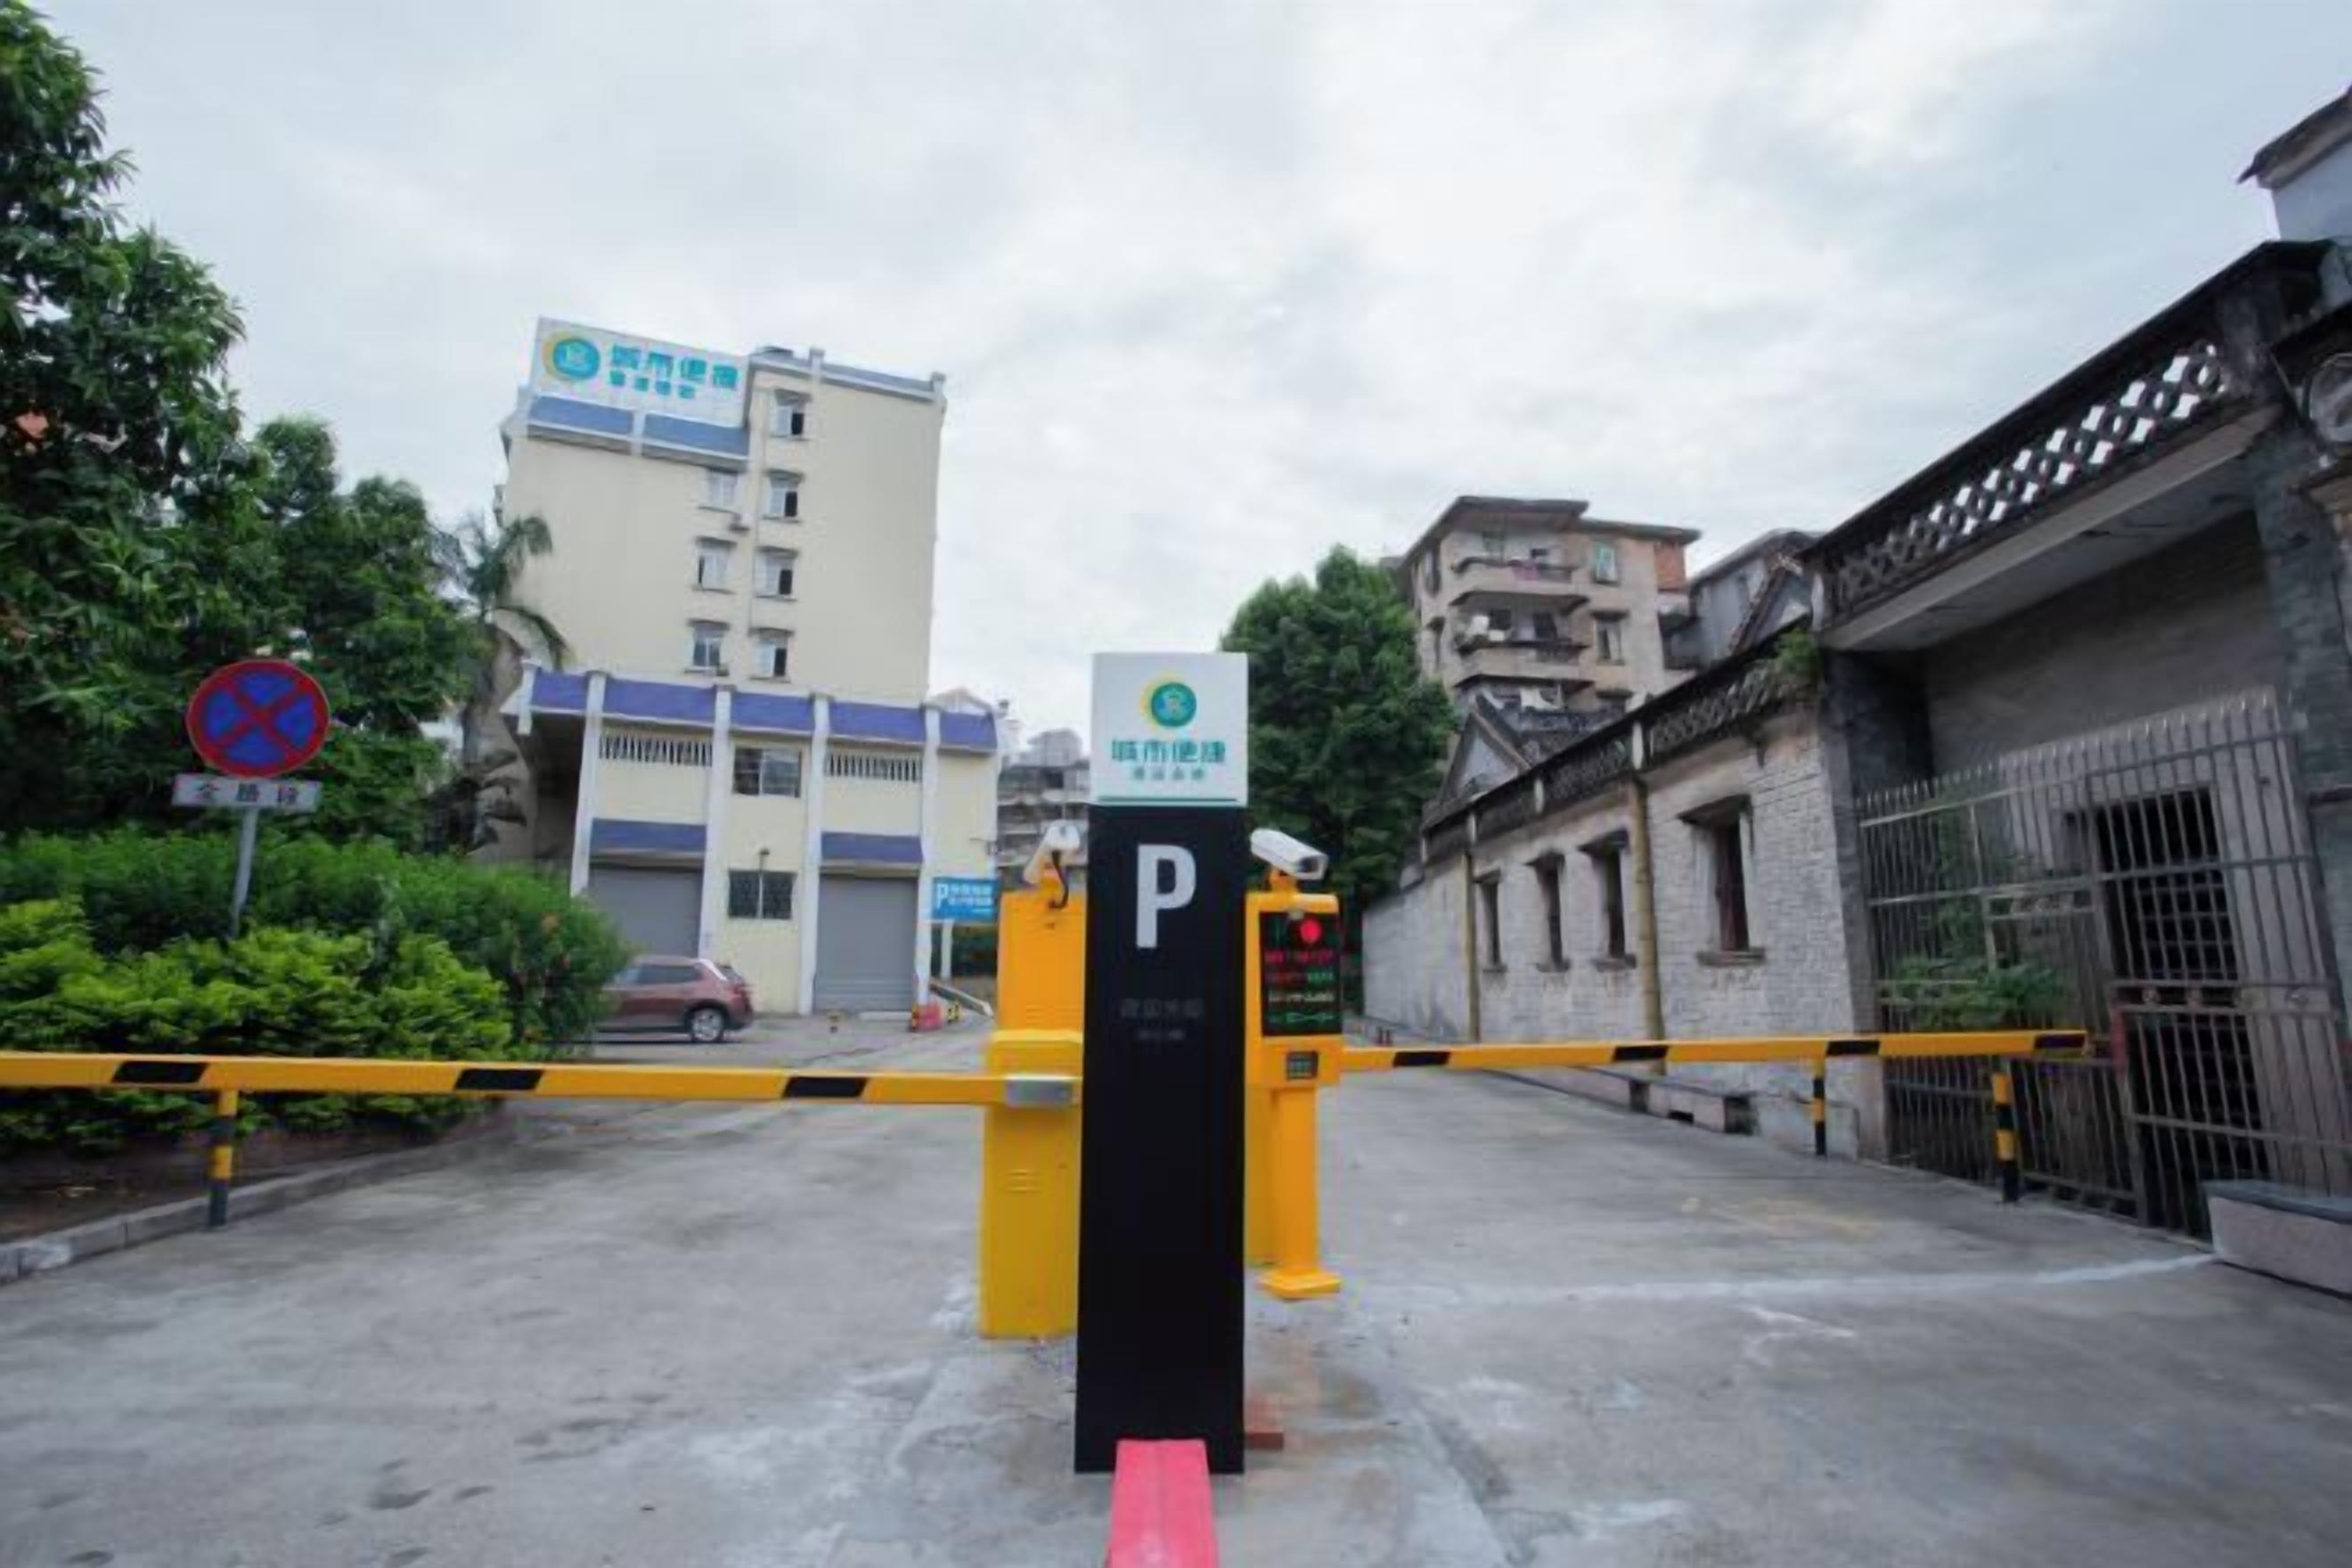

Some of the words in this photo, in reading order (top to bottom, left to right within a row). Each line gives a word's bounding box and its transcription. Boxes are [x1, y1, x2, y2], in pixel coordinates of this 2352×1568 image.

[1112, 740, 1226, 763] 城市便捷
[936, 883, 949, 910] P
[1136, 844, 1196, 949] P
